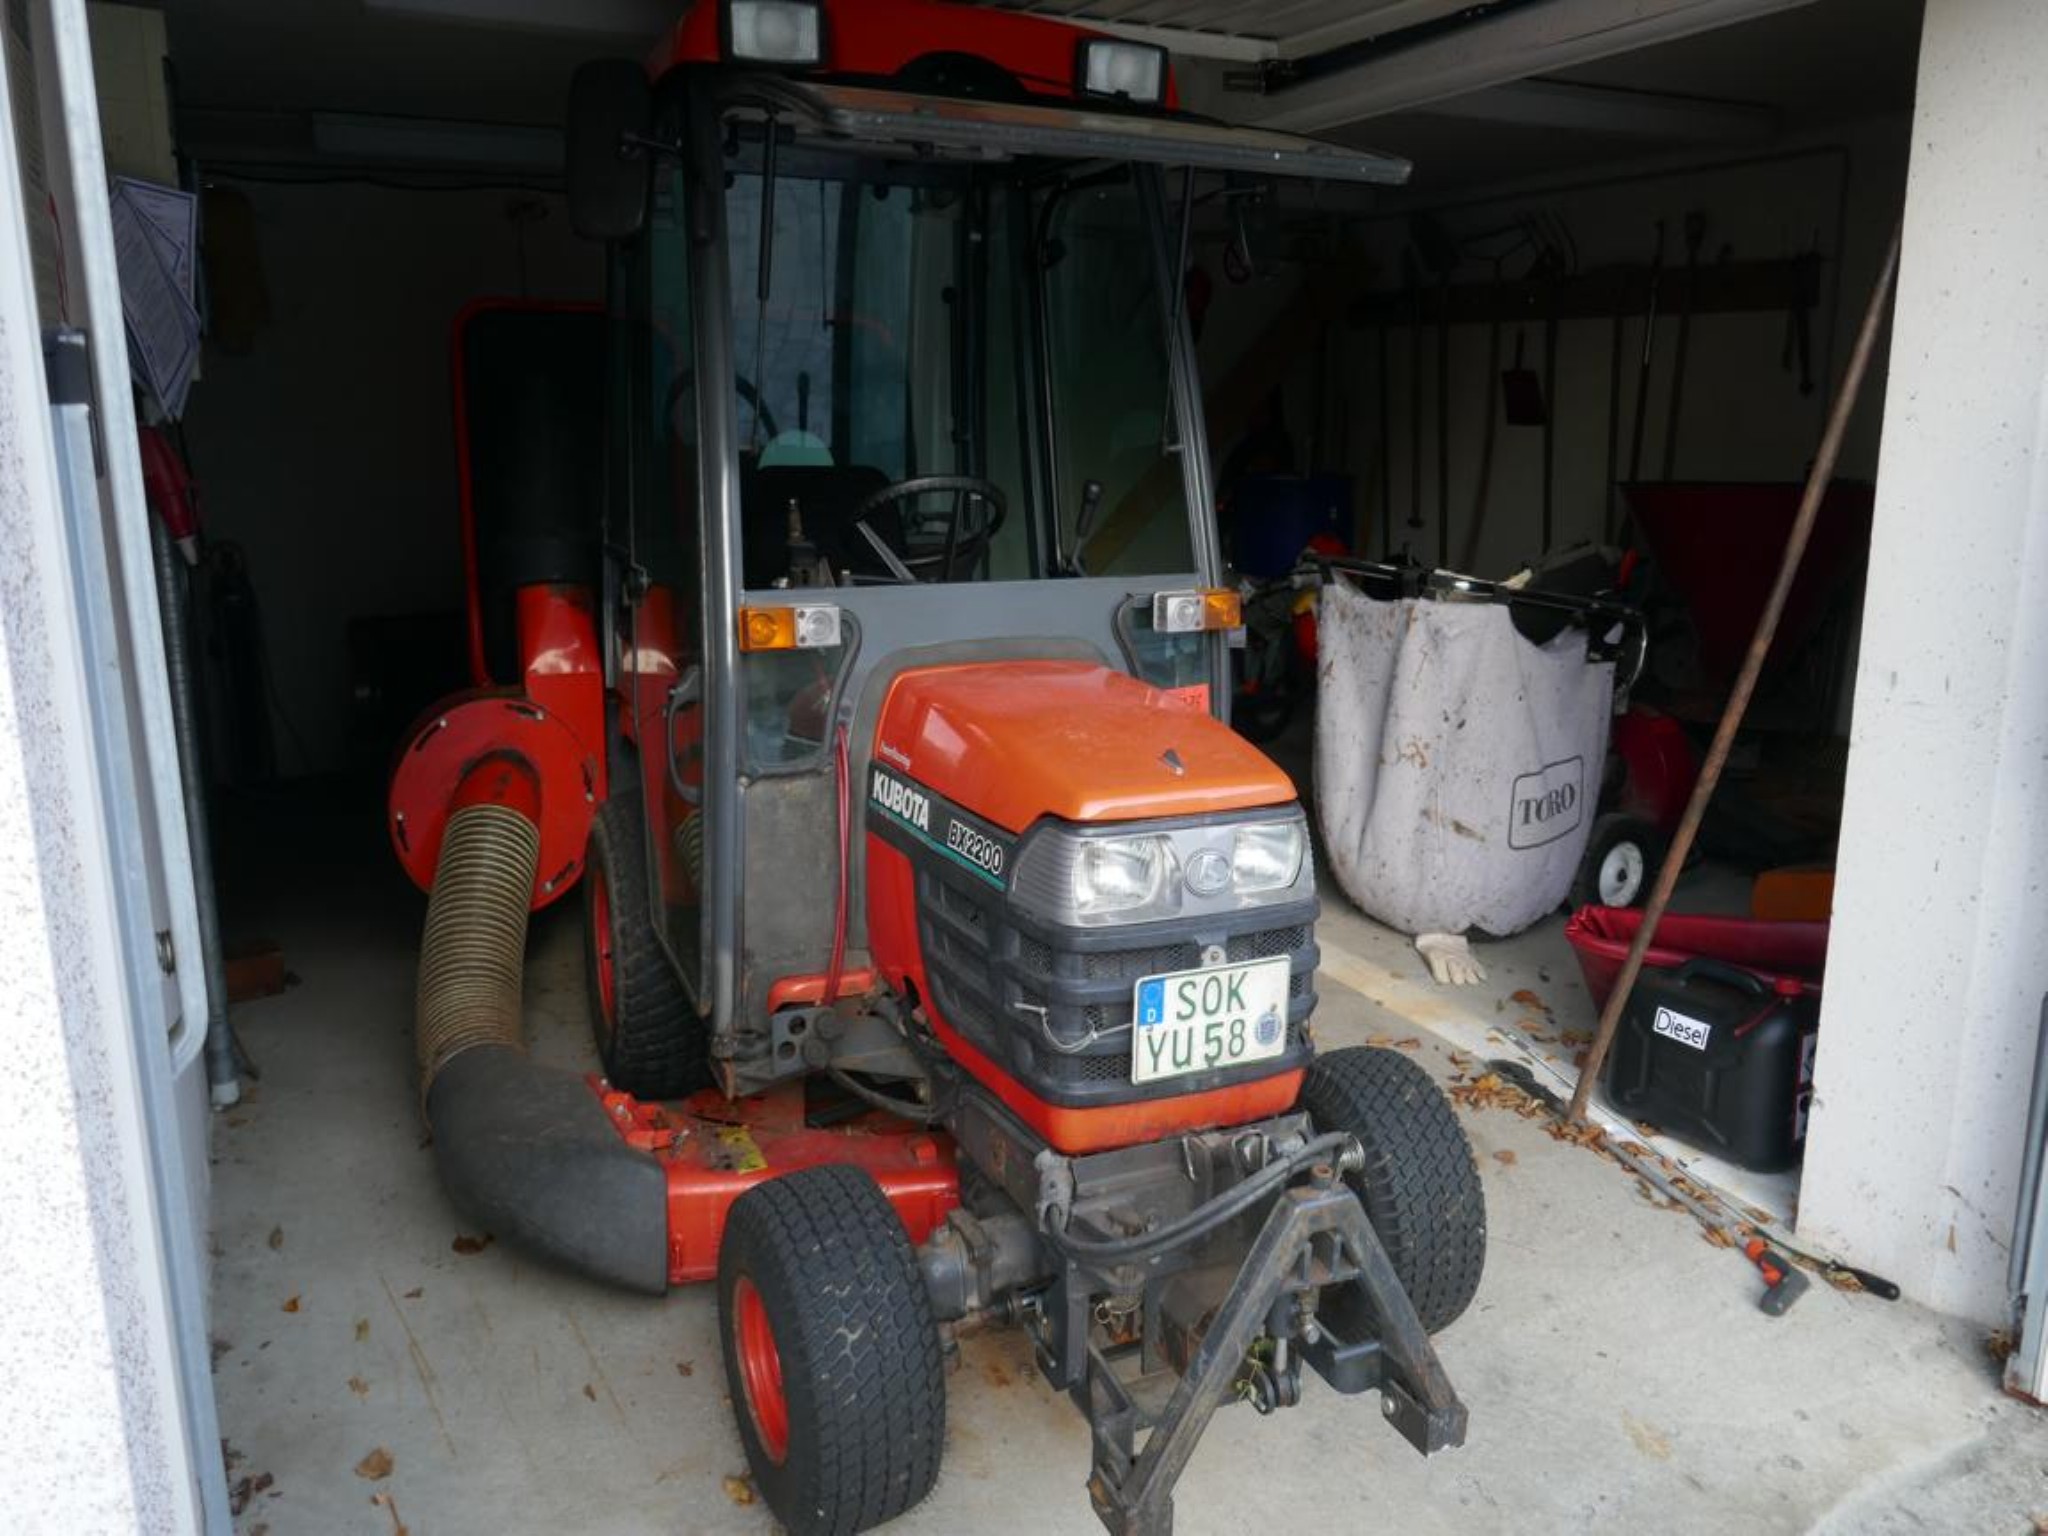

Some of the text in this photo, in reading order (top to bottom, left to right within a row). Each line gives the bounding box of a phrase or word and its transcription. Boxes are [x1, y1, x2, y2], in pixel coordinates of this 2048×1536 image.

[873, 770, 929, 832] KUBOTA
[1518, 783, 1576, 825] TORO
[946, 819, 1003, 875] BX2200
[1147, 1009, 1156, 1022] D
[1176, 971, 1248, 1020] SOK
[1147, 1027, 1193, 1072] YU
[1204, 1019, 1245, 1062] 58
[1656, 1009, 1708, 1047] Diesel
